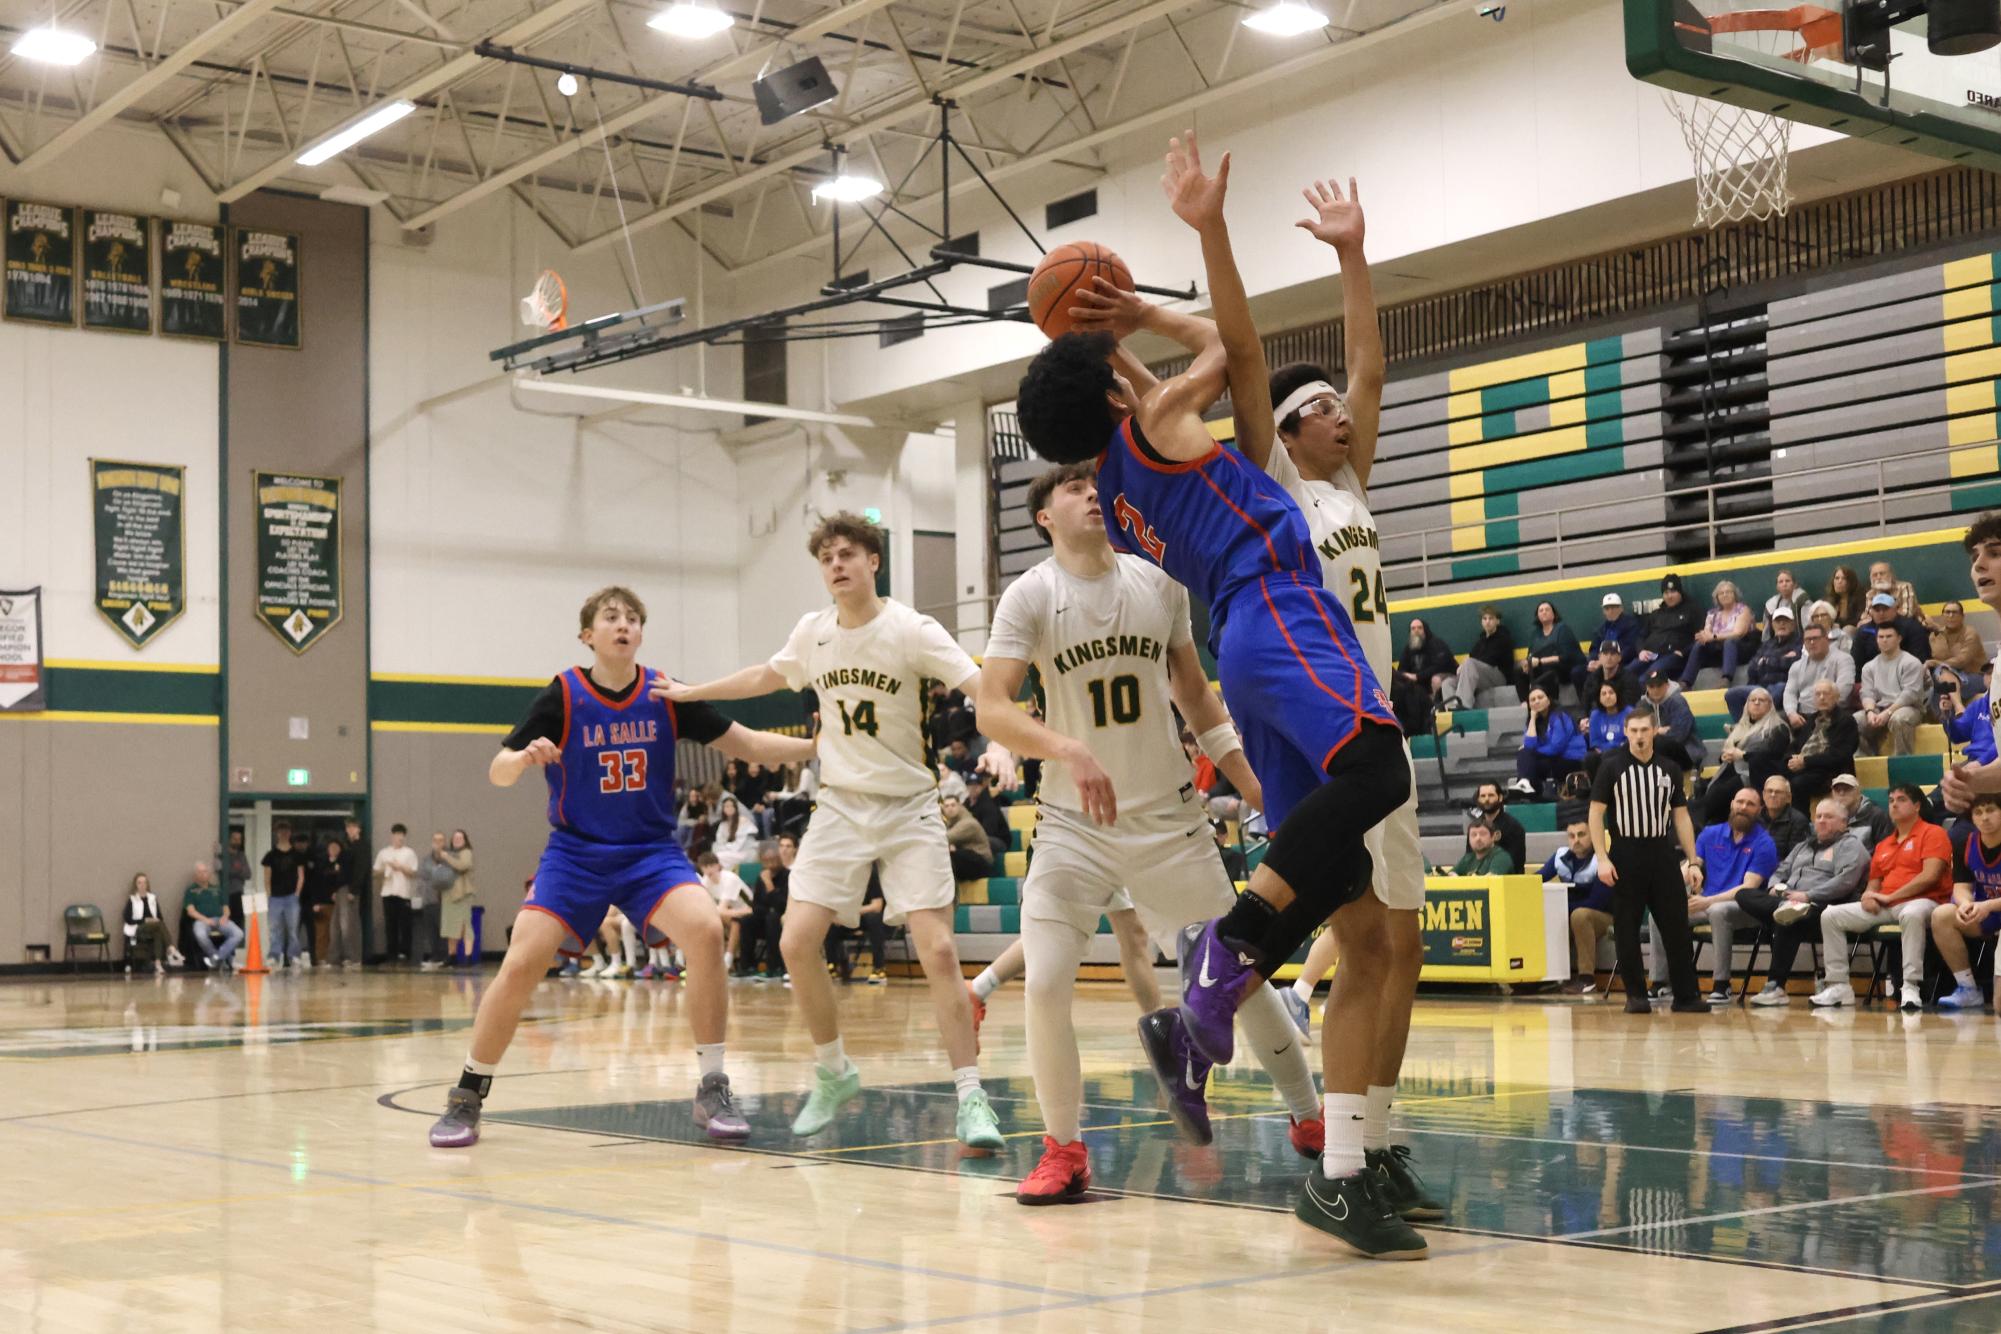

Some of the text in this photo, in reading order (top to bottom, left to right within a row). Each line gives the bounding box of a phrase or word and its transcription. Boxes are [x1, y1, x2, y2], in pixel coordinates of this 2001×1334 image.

[1113, 492, 1166, 567] 2
[1053, 635, 1164, 676] KINGSMEN
[836, 699, 879, 737] 14
[1087, 673, 1142, 729] 10
[583, 720, 657, 748] LA SALLE
[598, 749, 648, 794] 33
